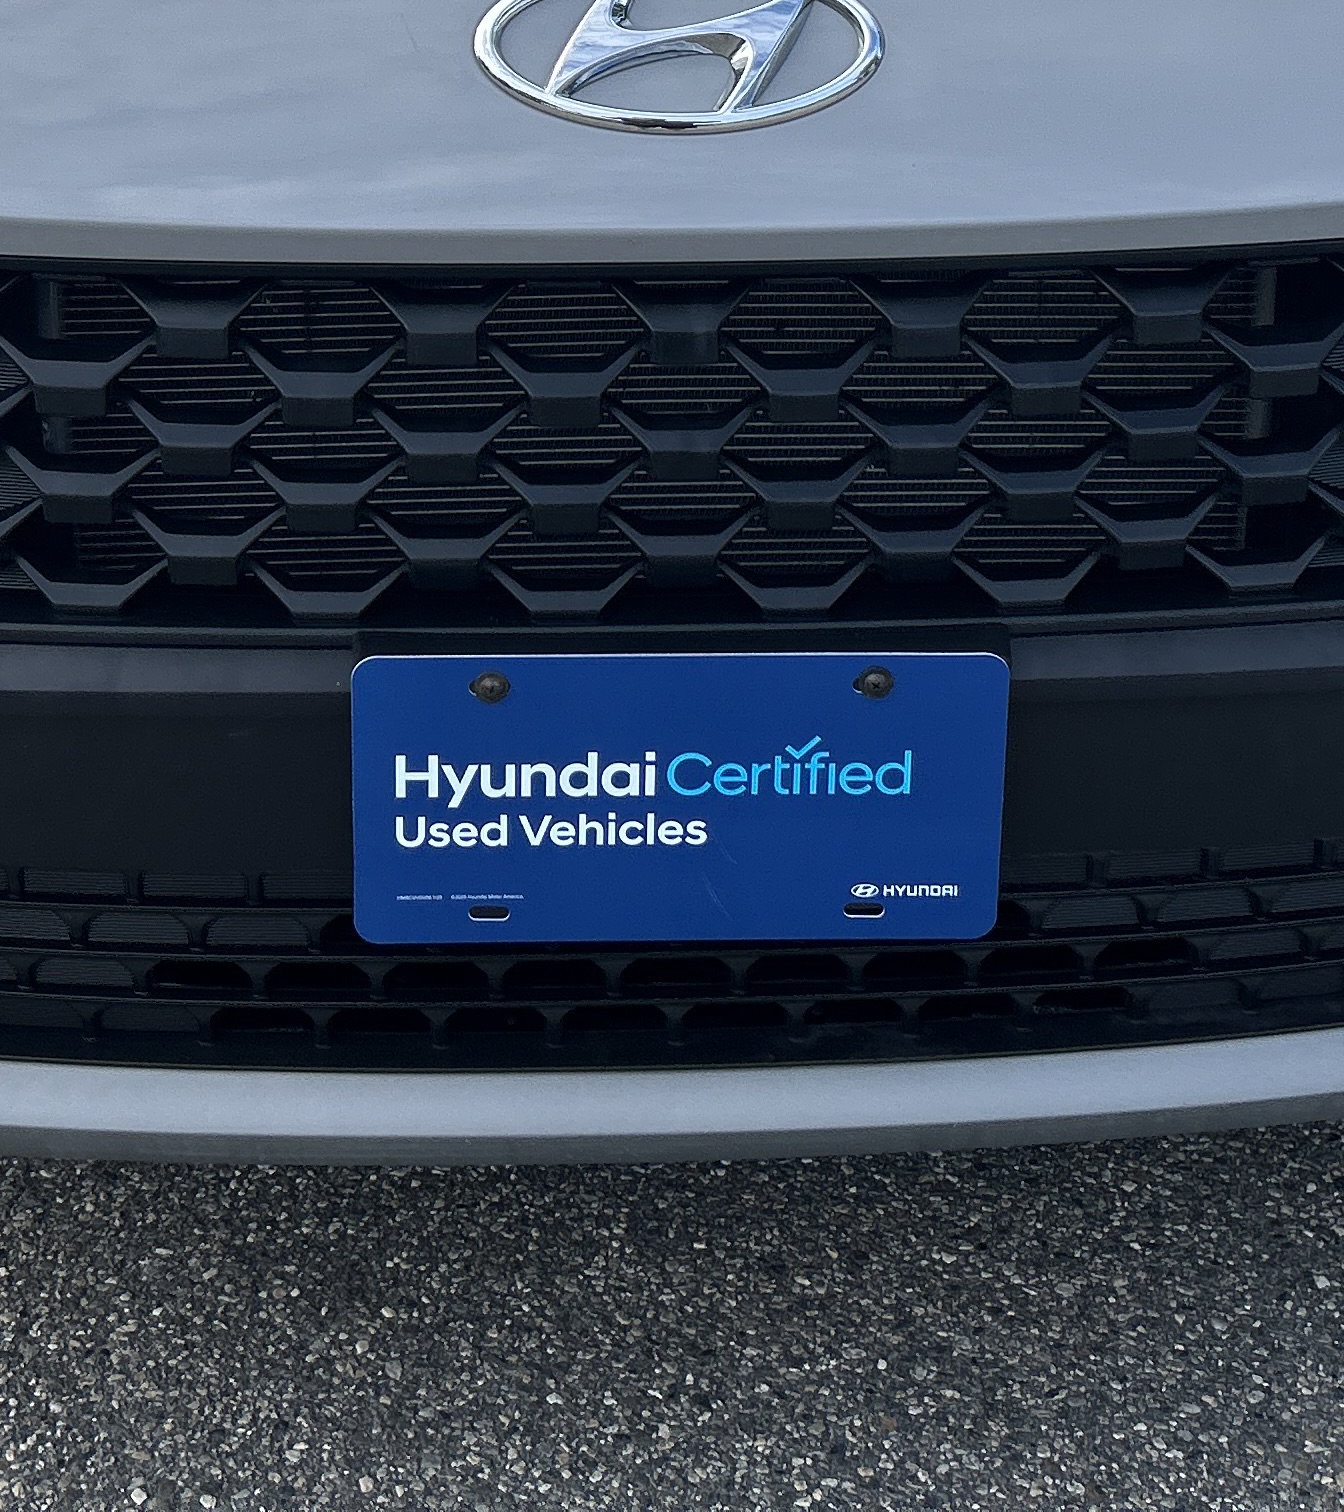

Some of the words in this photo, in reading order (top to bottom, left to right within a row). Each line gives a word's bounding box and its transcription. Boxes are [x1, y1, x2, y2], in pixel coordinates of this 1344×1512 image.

[395, 751, 657, 809] Hyundai
[666, 735, 913, 797] Certified
[395, 814, 508, 849] Used
[518, 811, 708, 848] Vehicles
[882, 884, 959, 897] HYUNDAI
